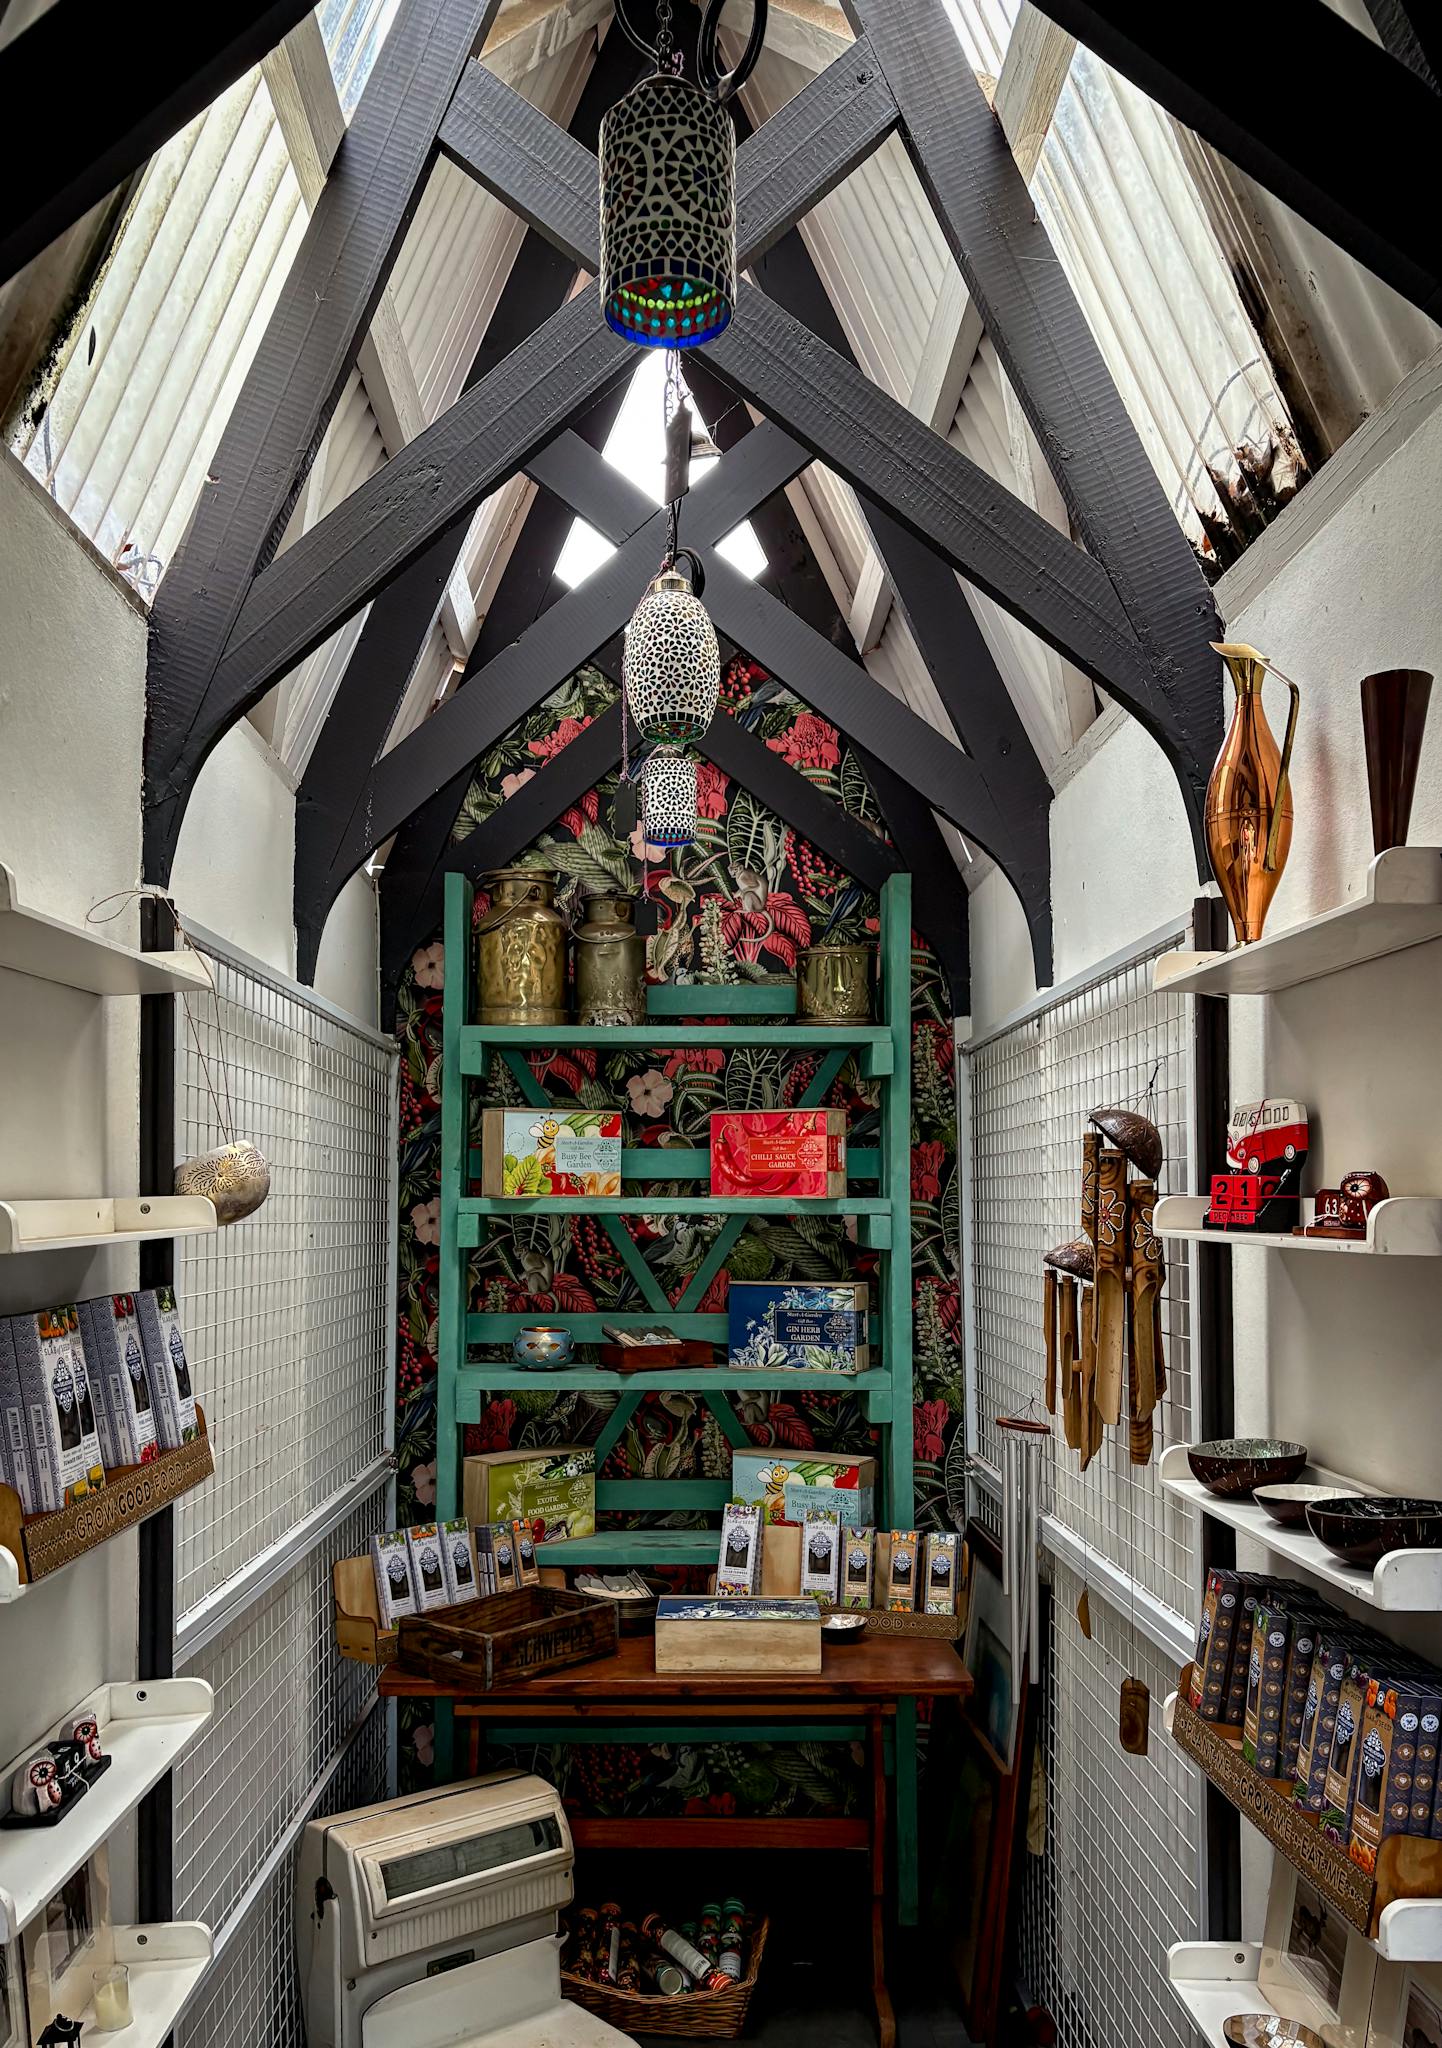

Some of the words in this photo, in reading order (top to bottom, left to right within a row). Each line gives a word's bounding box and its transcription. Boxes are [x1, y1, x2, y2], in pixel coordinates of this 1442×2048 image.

[561, 1152, 577, 1161] Busy
[579, 1152, 592, 1160] Bee
[566, 1160, 592, 1168] Garden
[1325, 1198, 1338, 1214] 63
[1213, 1211, 1248, 1221] DECMBER
[786, 1325, 800, 1333] GIN
[801, 1326, 821, 1334] HERB
[790, 1334, 821, 1342] GARDEN
[75, 1498, 114, 1540] GROW
[118, 1480, 152, 1516] GOOD
[153, 1462, 184, 1497] FOOD
[537, 1495, 560, 1505] EXOTIC
[528, 1507, 545, 1516] FOOD
[545, 1502, 570, 1513] GARDEN
[791, 1500, 808, 1510] Busy
[811, 1501, 825, 1511] Bee
[867, 1614, 904, 1630] OOD
[1185, 1720, 1217, 1760] PLANT
[1240, 1777, 1274, 1820] GROW
[1273, 1813, 1294, 1845] ME
[1300, 1833, 1324, 1870] EAT
[1324, 1862, 1347, 1896] ME
